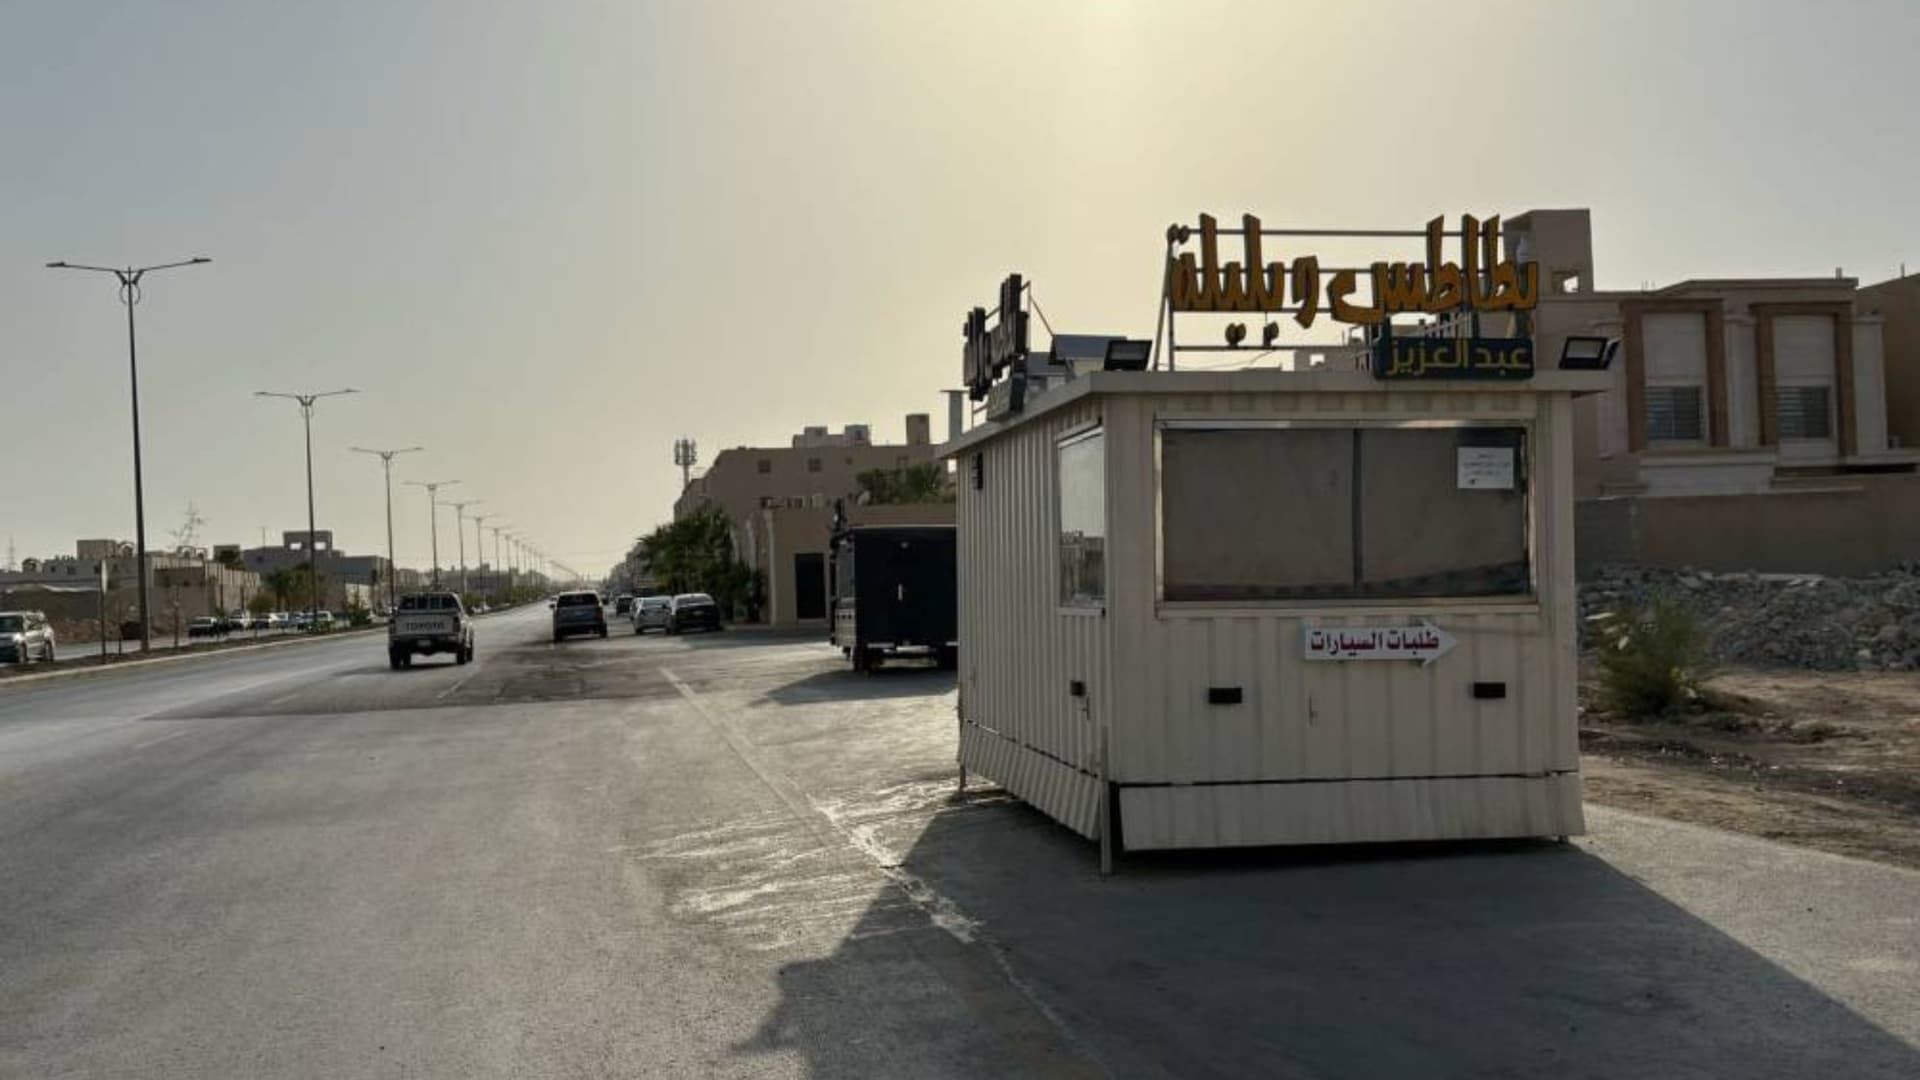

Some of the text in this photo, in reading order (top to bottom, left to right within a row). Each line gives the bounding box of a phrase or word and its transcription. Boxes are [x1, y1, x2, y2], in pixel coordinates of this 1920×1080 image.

[1386, 338, 1531, 376] عبد العزيز
[405, 621, 445, 632] TOYOTA
[1310, 628, 1440, 656] طلبات السيارات
